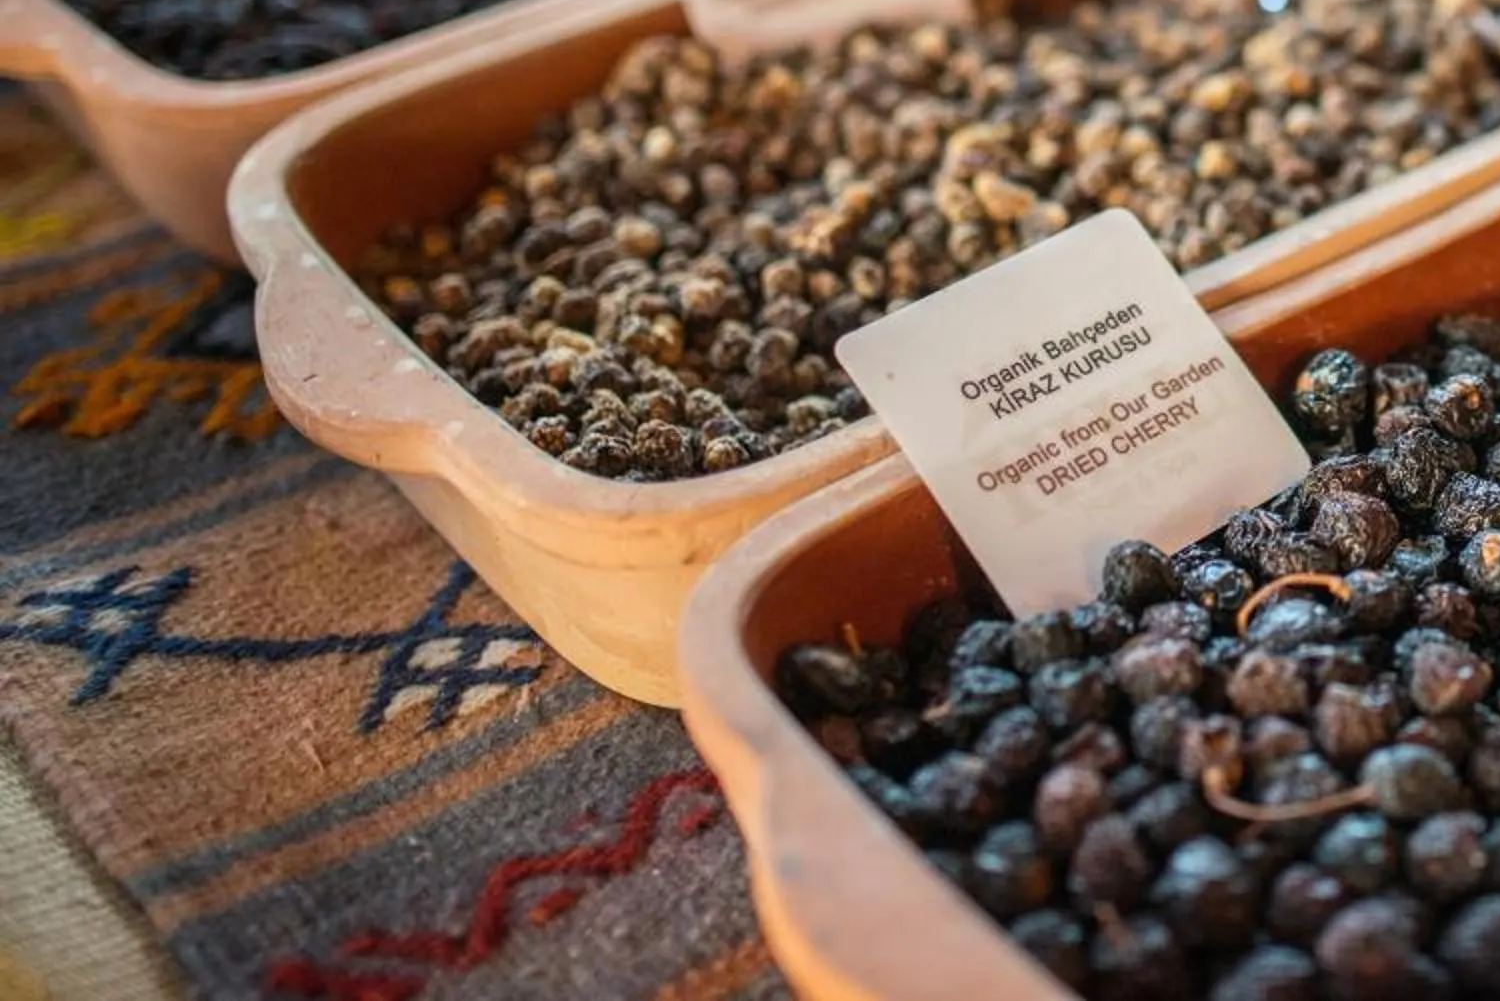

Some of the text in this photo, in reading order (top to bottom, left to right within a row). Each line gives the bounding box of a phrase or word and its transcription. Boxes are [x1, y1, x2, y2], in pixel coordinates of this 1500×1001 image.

[960, 302, 1143, 400] Organik Bahçeden
[989, 326, 1153, 419] KİRAZ KURUSU
[976, 356, 1225, 492] Organic from Our Garden
[1036, 396, 1201, 495] DRIED CHERRY
